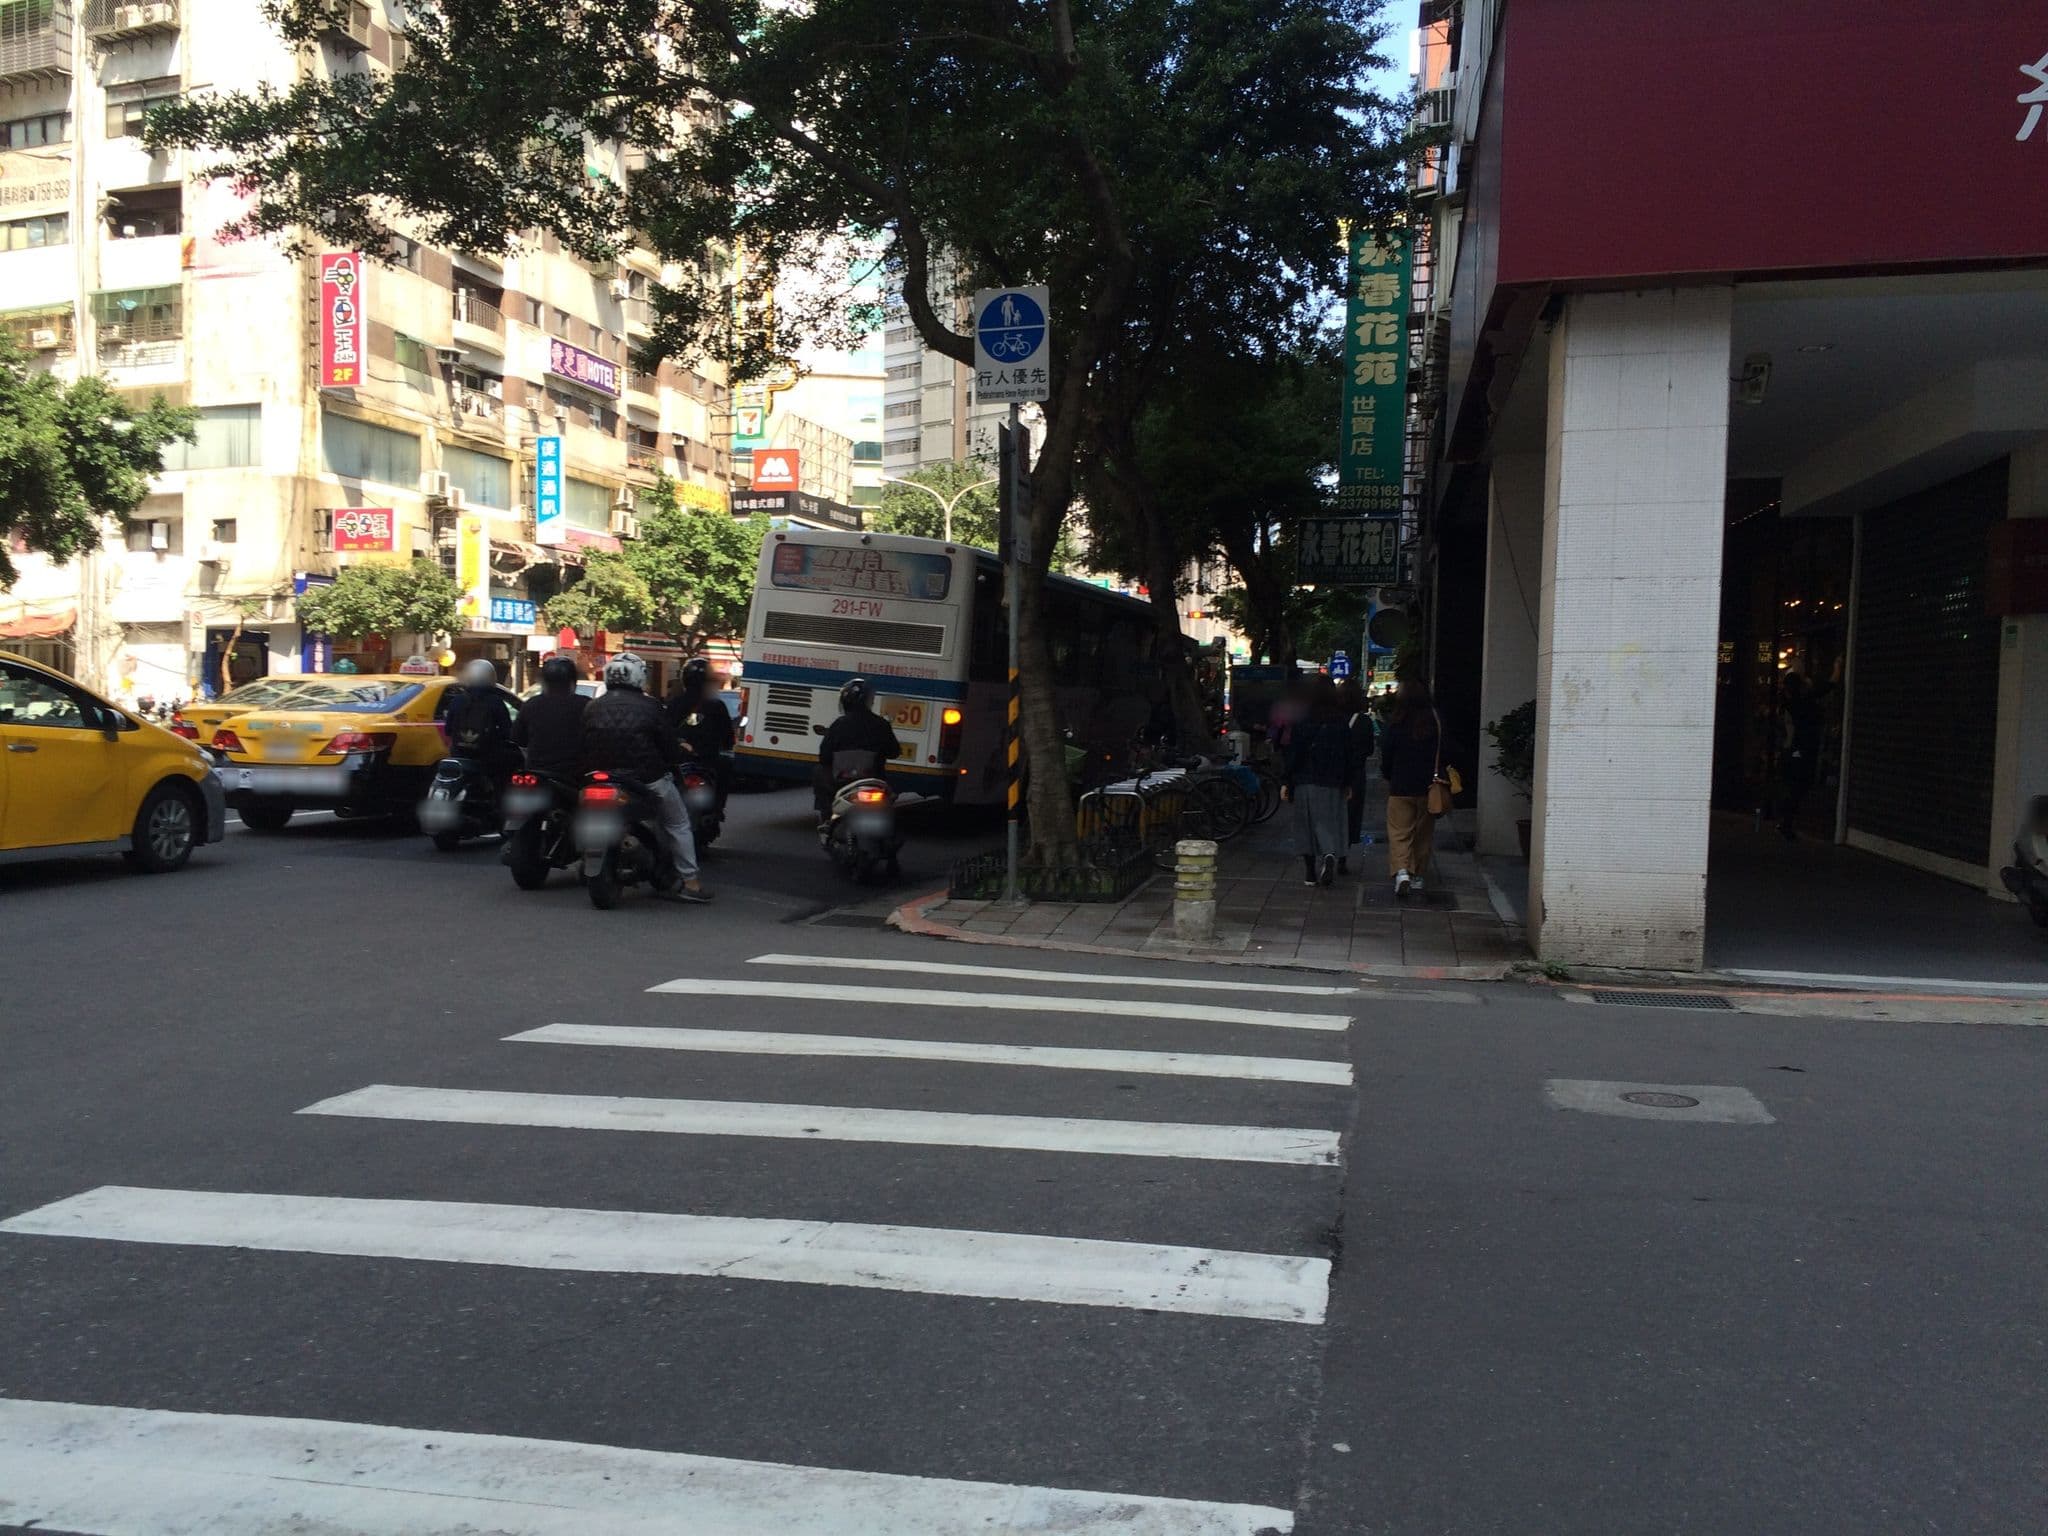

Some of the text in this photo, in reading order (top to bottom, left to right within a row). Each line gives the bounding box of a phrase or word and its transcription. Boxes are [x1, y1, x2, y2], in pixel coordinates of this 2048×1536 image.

[1354, 233, 1402, 386] 永春花苑
[332, 368, 353, 382] 2F
[588, 360, 614, 389] HOTEL
[977, 367, 1047, 387] 行人優先
[1355, 467, 1385, 479] TEL:
[1340, 485, 1400, 497] 23789162
[831, 599, 884, 617] 291-FW
